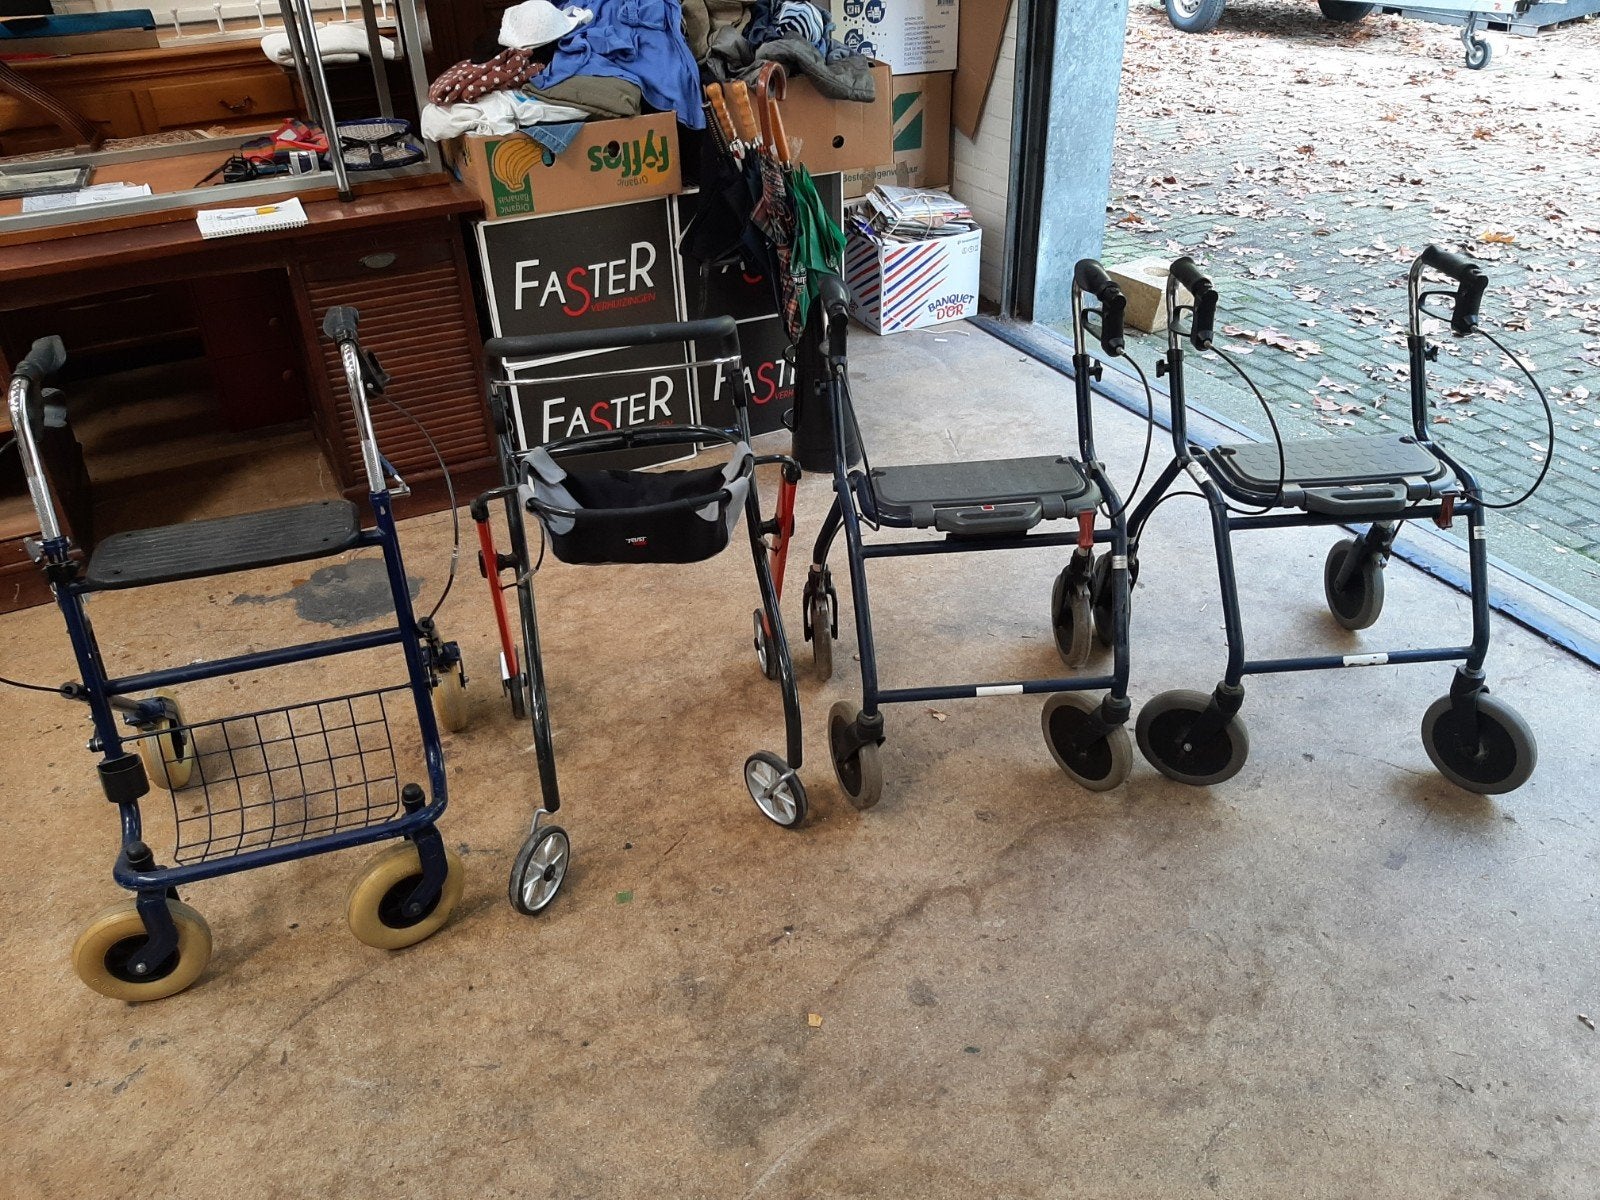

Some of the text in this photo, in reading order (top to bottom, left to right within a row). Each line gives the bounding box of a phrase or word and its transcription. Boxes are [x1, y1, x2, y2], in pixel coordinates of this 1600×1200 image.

[617, 174, 648, 187] Organic
[500, 203, 530, 214] Organic
[515, 241, 656, 317] FASTER
[591, 292, 657, 312] VERHUIZINGEN
[936, 303, 963, 320] D'OR
[543, 375, 674, 444] FASTER
